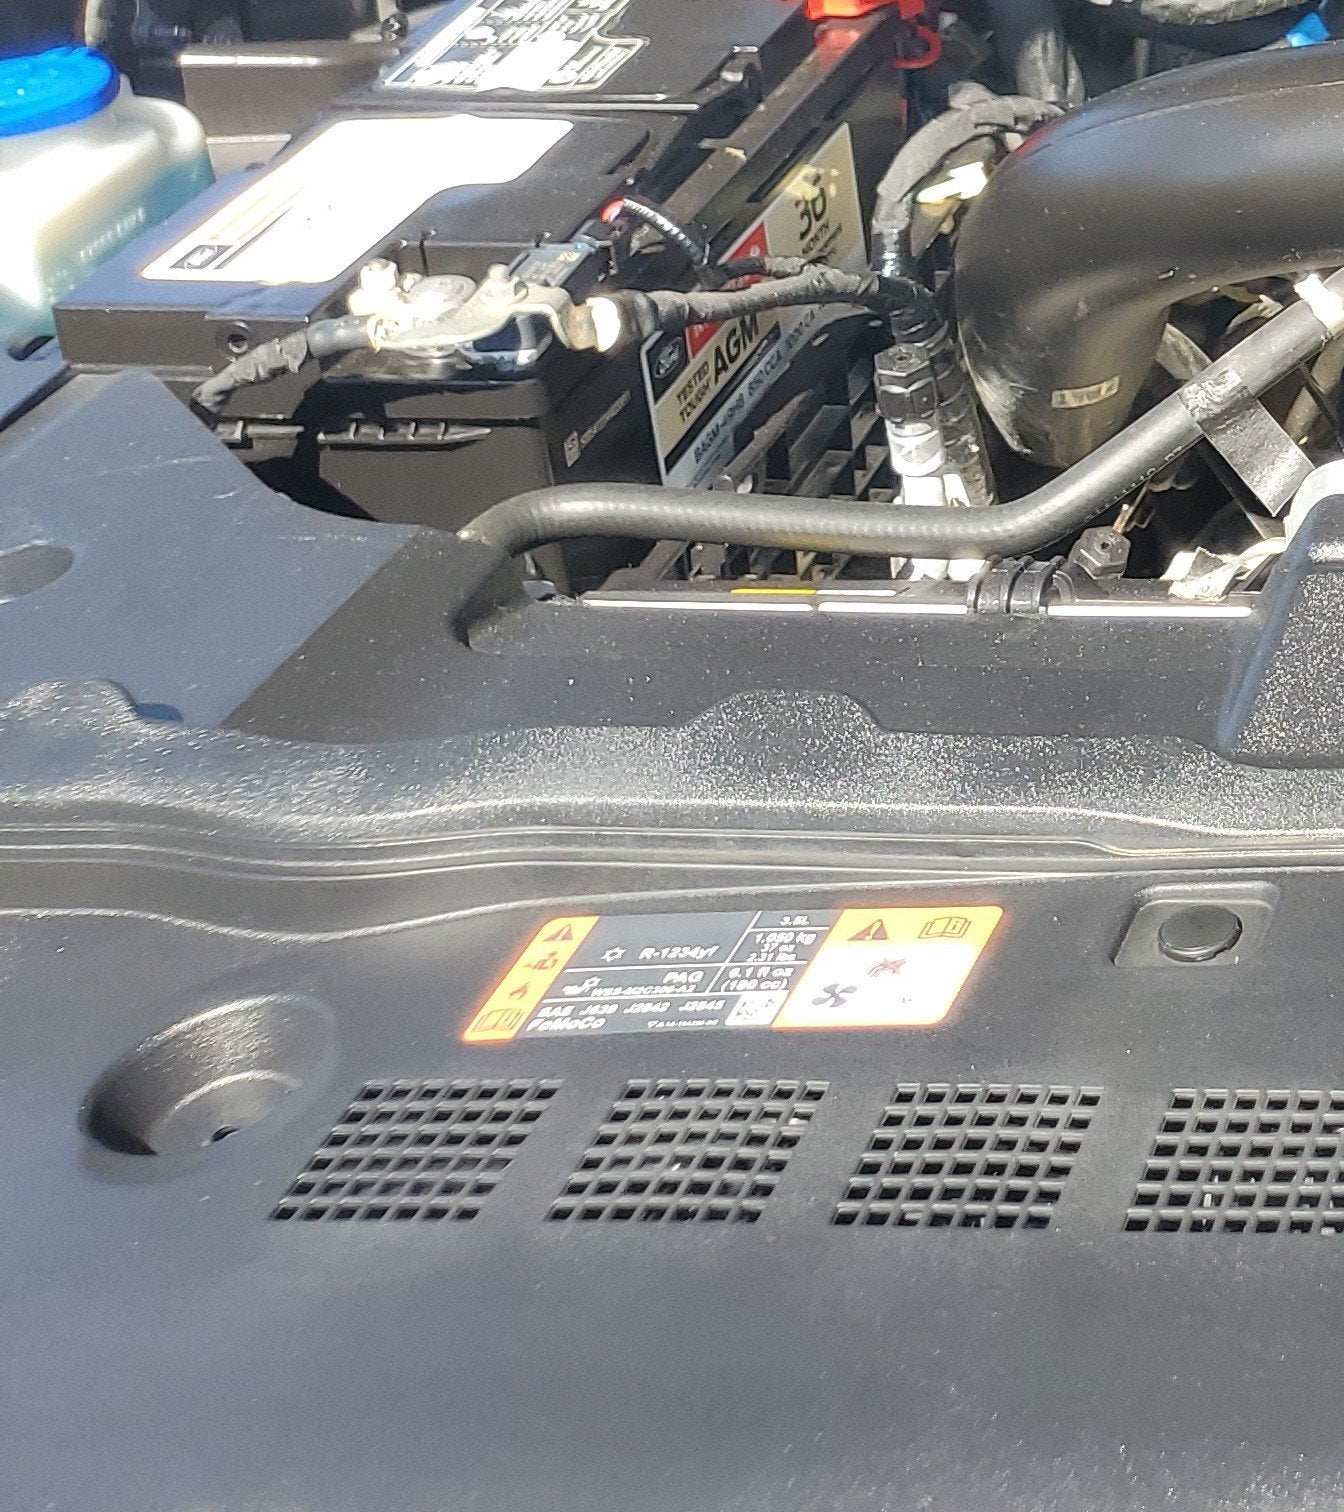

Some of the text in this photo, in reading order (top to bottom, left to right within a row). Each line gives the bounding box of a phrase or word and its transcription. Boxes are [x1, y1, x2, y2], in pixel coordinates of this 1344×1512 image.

[713, 312, 759, 385] AGM
[676, 360, 710, 405] TESTED
[796, 931, 817, 945] kg
[638, 945, 720, 960] R-1234yf
[662, 971, 704, 984] PAG
[771, 967, 795, 978] oz
[760, 979, 788, 992] cc)
[537, 1004, 575, 1018] SAE
[525, 1016, 607, 1032] FoMoCo
